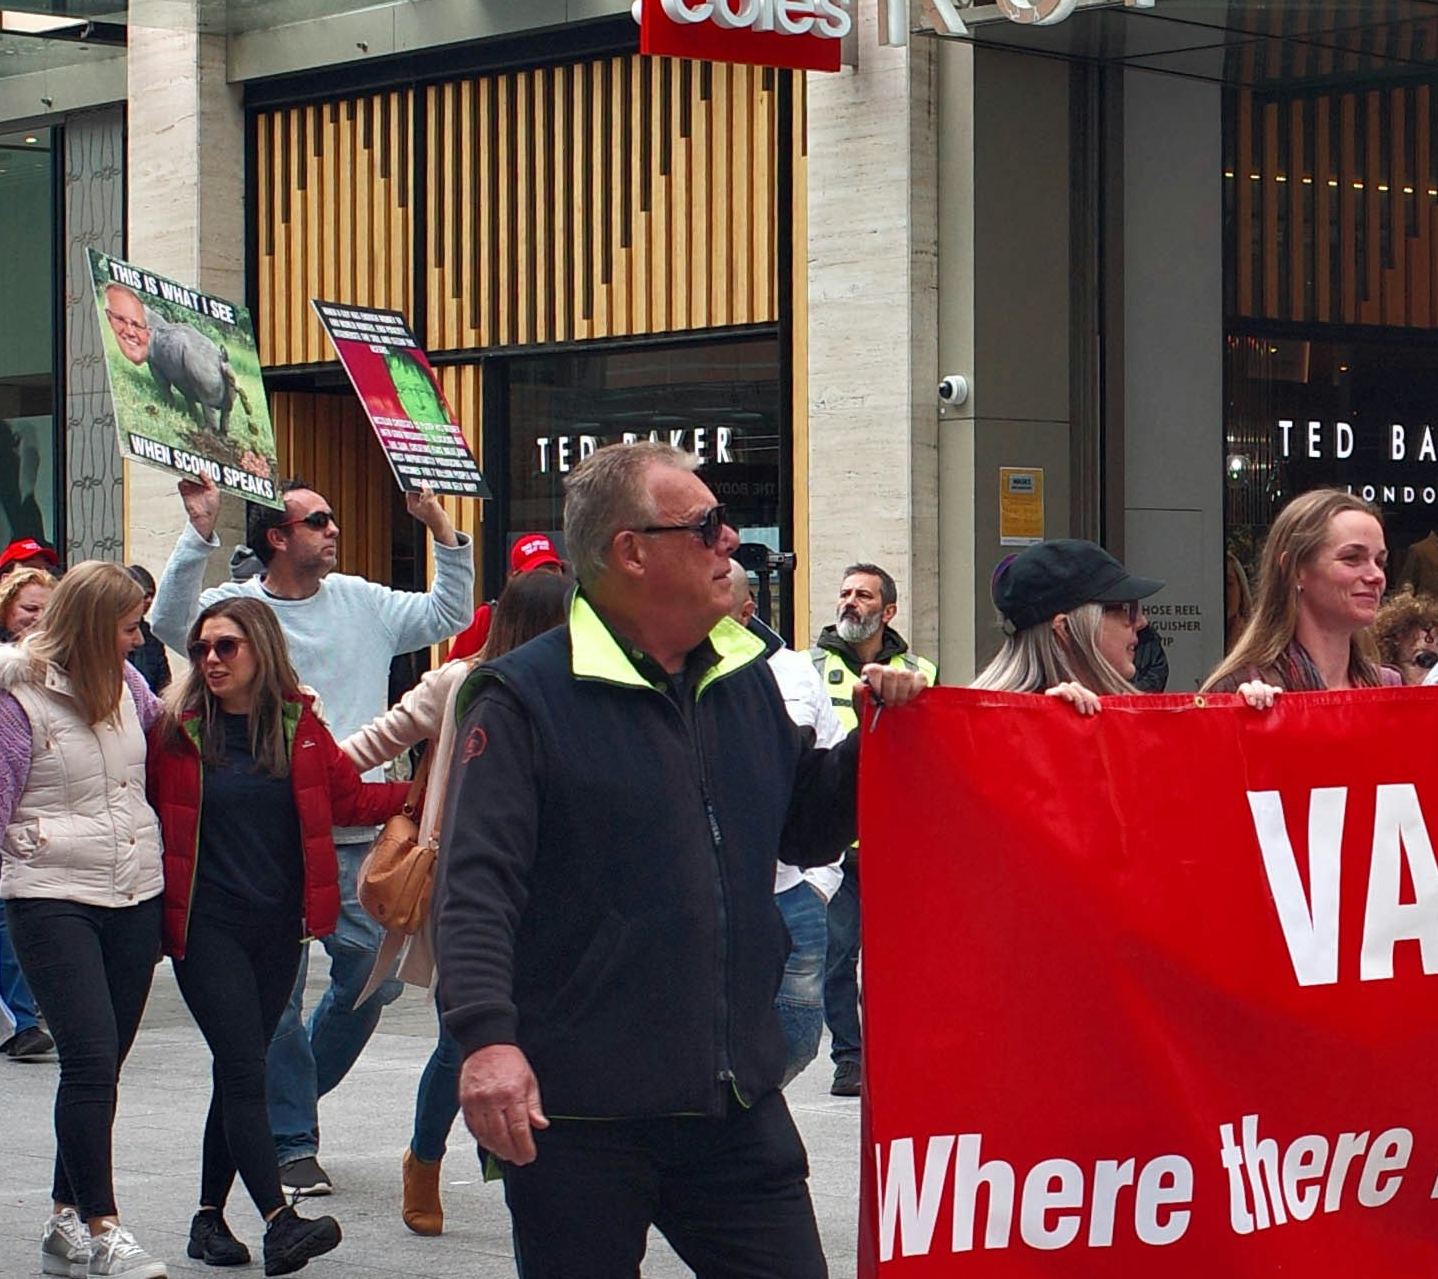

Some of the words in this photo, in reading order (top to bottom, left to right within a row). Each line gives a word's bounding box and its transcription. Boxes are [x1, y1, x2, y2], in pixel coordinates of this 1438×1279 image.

[110, 261, 142, 290] THIS
[145, 274, 160, 296] IS
[159, 280, 200, 309] WHAT
[202, 294, 210, 315] I
[211, 298, 236, 324] SEE
[536, 434, 596, 473] TED
[1279, 420, 1355, 459] TED
[130, 434, 173, 467] WHEN
[174, 448, 221, 481] SCOMO
[223, 465, 275, 500] SPEAKS
[1142, 604, 1172, 615] HOSE
[1175, 604, 1202, 615] REEL
[1152, 621, 1201, 631] GUISHER
[874, 1132, 1195, 1263] Where
[1219, 1111, 1411, 1235] there
